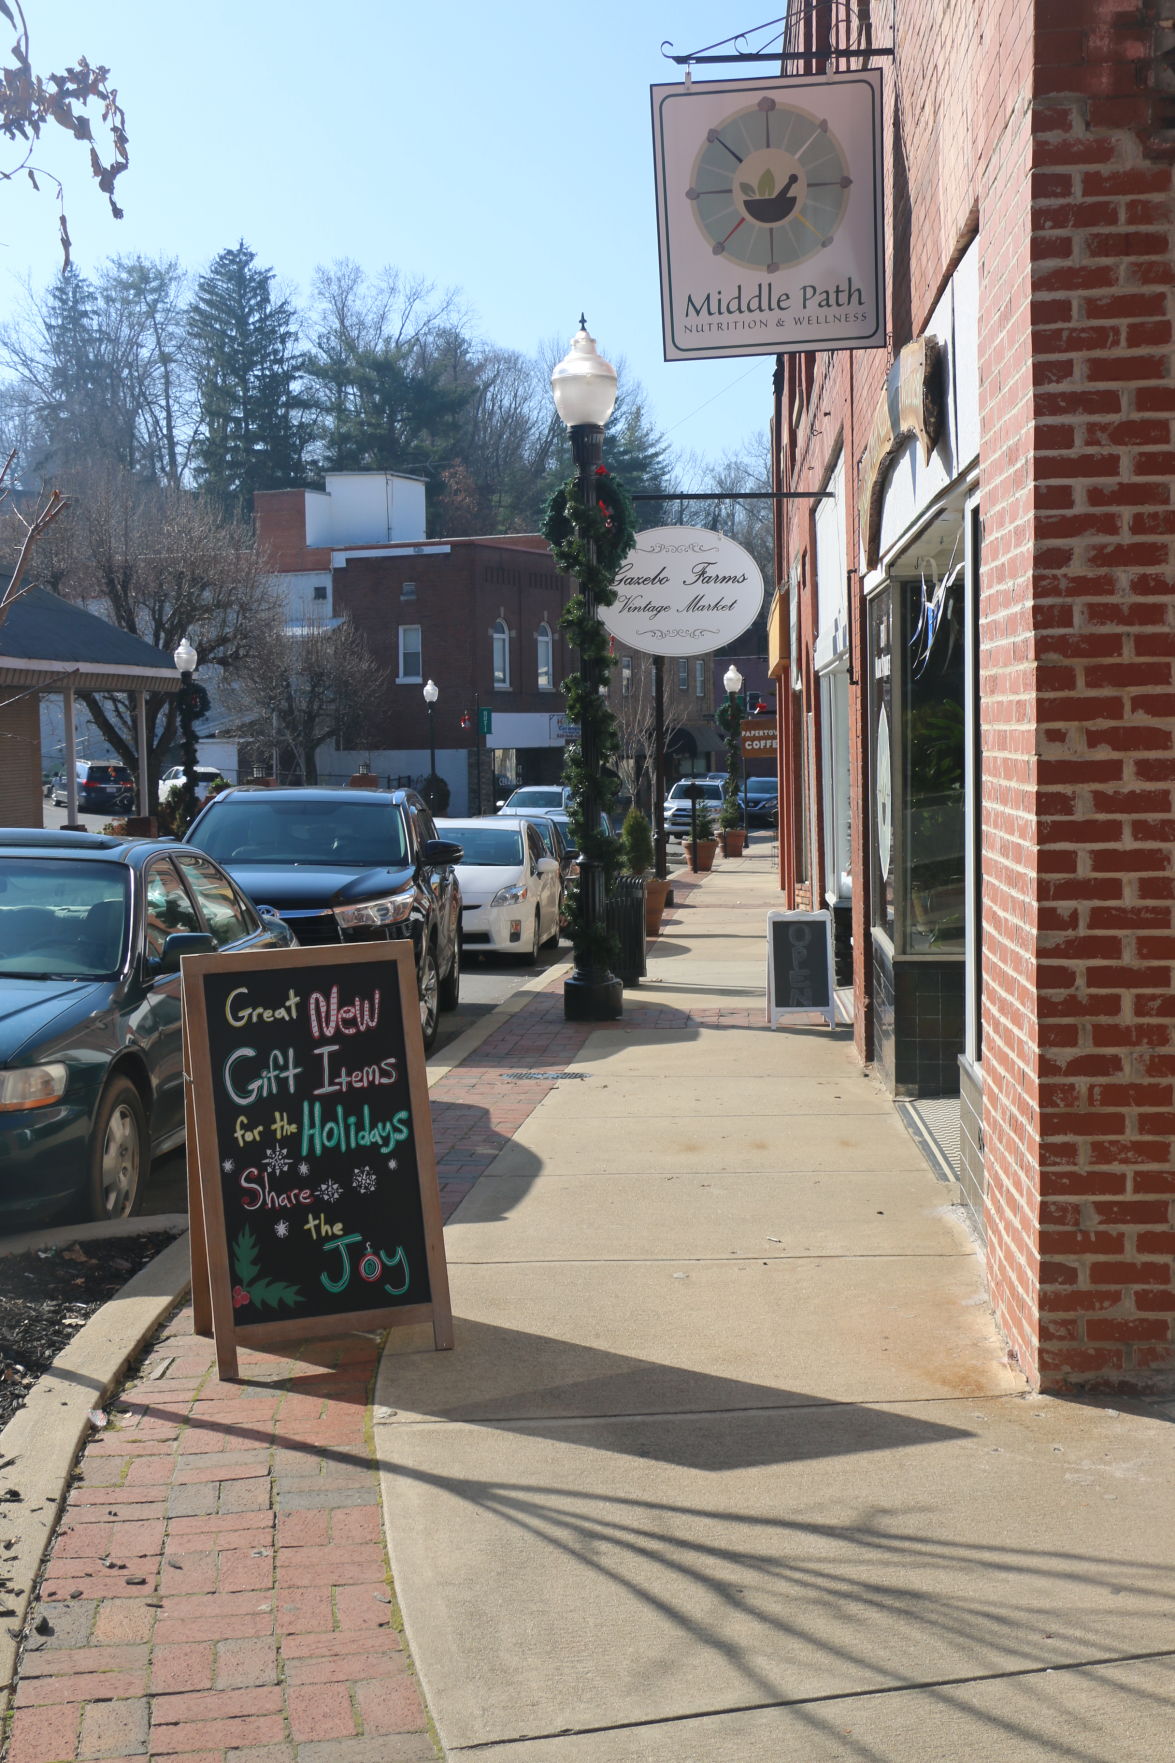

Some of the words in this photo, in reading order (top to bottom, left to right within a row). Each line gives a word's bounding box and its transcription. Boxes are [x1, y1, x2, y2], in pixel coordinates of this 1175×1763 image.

[685, 282, 791, 318] Middle
[801, 277, 866, 310] Path
[684, 319, 768, 334] NUTRITION
[775, 317, 786, 327] &
[794, 312, 868, 325] WELLNESS
[611, 562, 671, 587] Gazebo
[683, 561, 748, 586] Farms
[616, 594, 671, 620] Vintage
[676, 594, 738, 613] Market
[741, 729, 778, 737] PAPERTOW
[744, 739, 778, 750] COFFE
[225, 986, 300, 1027] Great
[308, 984, 380, 1039] New
[223, 1046, 304, 1105] Gift
[312, 1044, 397, 1095] Items
[234, 1116, 264, 1148] for
[270, 1111, 298, 1141] the
[300, 1100, 410, 1158] Holidays
[239, 1167, 315, 1211] Share
[304, 1213, 345, 1241] the
[320, 1232, 410, 1295] Joy
